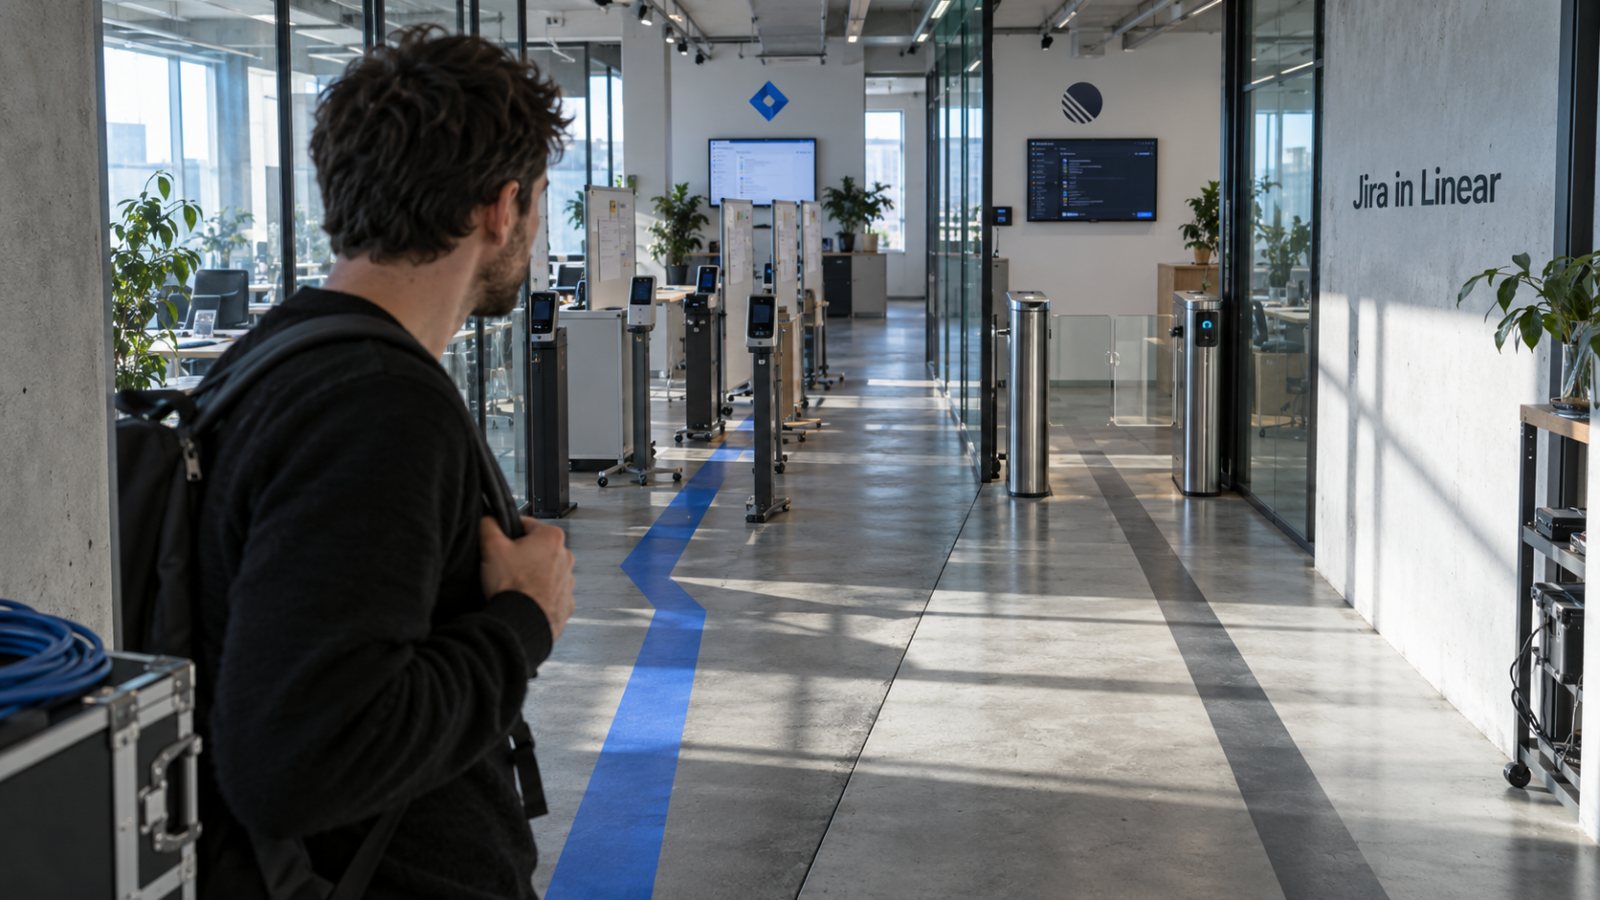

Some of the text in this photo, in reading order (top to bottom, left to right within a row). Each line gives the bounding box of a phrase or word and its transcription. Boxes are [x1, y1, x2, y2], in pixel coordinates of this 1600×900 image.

[1353, 167, 1501, 209] Jira in Linear
